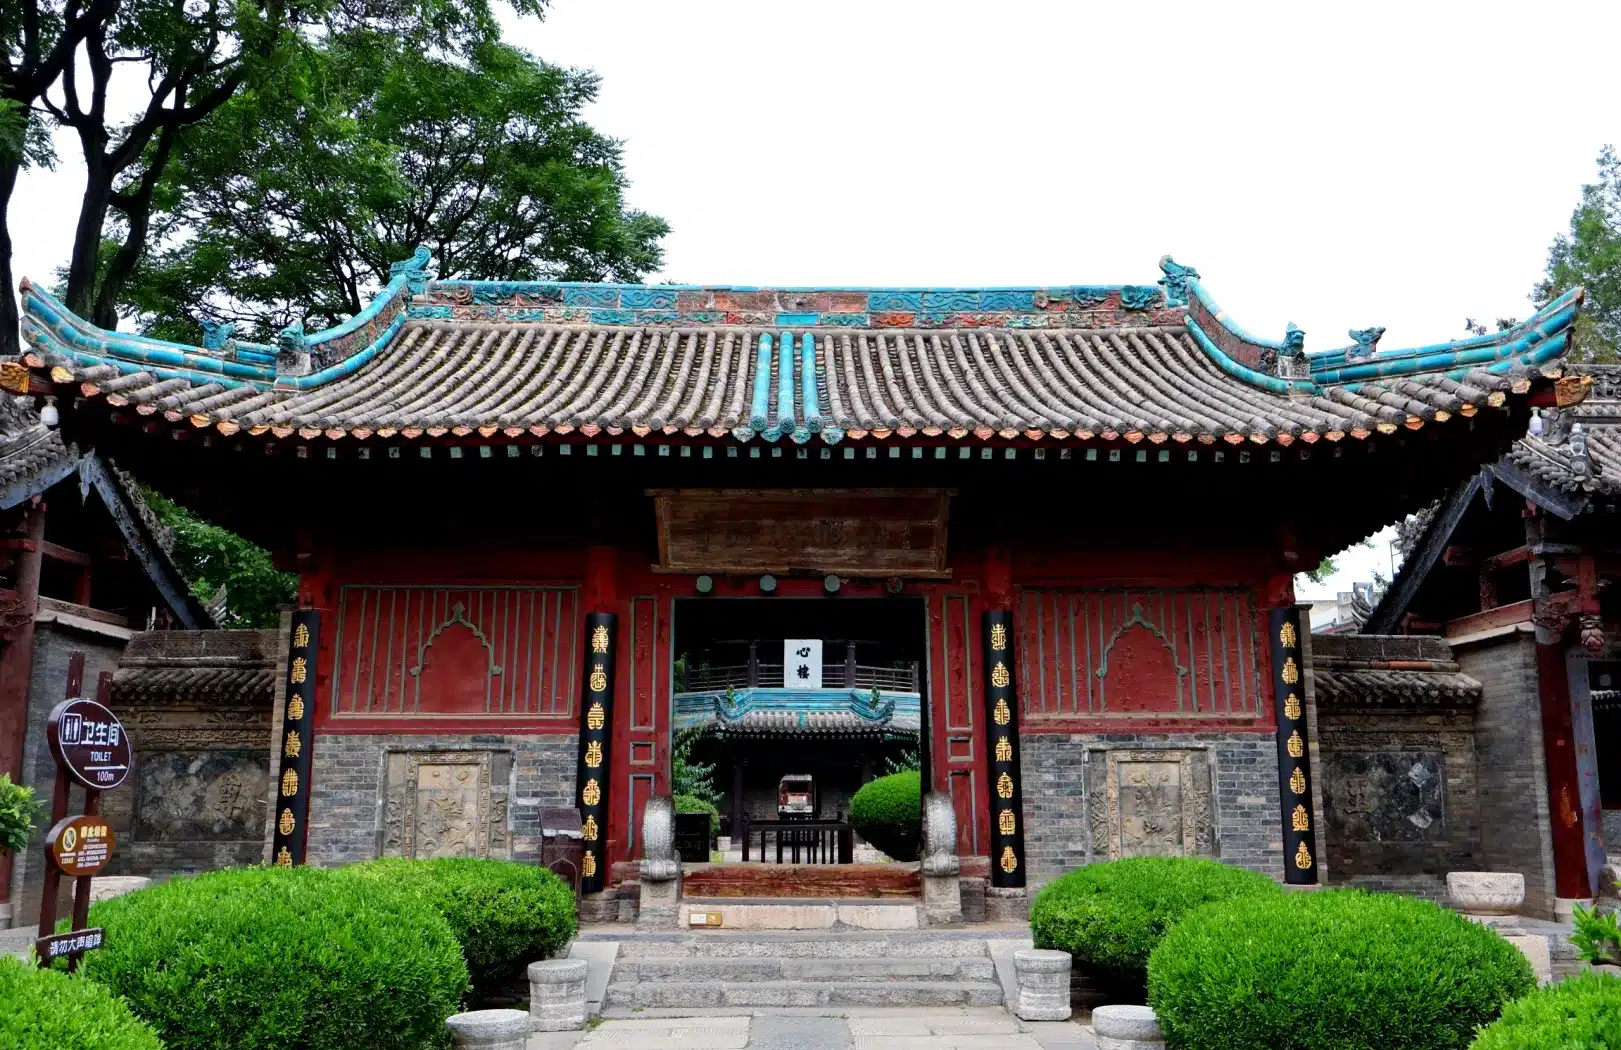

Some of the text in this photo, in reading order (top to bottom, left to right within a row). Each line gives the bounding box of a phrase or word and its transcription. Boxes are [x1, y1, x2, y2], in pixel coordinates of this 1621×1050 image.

[81, 717, 120, 746] 卫生间
[90, 751, 112, 762] TOILET
[97, 771, 114, 781] 100m
[50, 933, 102, 956] 请勿大声喧哗
